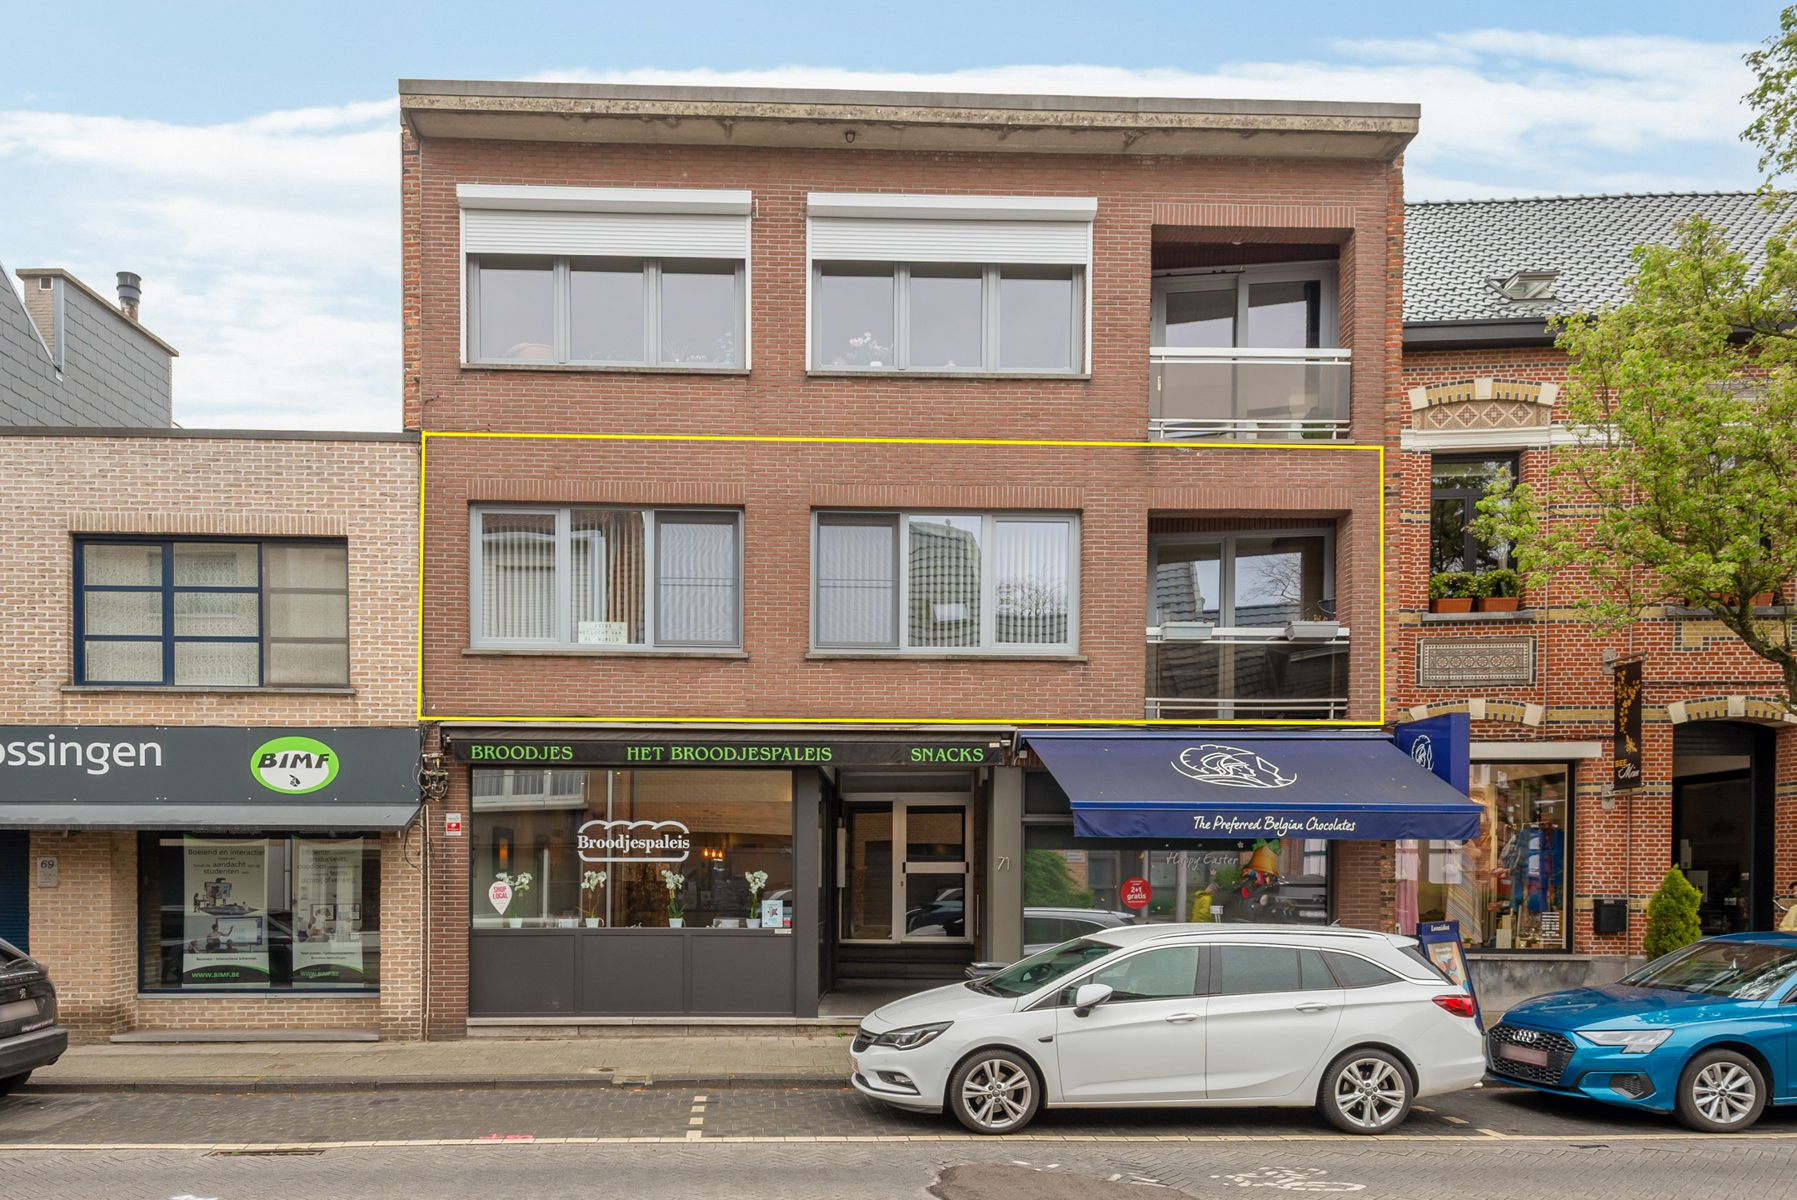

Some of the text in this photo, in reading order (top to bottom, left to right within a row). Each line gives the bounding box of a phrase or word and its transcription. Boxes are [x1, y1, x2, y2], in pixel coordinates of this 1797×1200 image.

[0, 733, 162, 775] ssingen
[470, 745, 573, 760] BROODJES
[627, 746, 833, 761] HET BROODJESPALEIS
[911, 747, 984, 762] SNACKS
[257, 752, 330, 769] BIMF
[1193, 815, 1356, 837] The Preferred Belgian Chocolates
[577, 834, 690, 854] Broodjespaleis
[40, 860, 54, 869] 69
[997, 856, 1010, 870] 71
[1165, 851, 1239, 871] Happy Easter
[1126, 892, 1147, 901] gratis
[1130, 886, 1142, 894] 2+1
